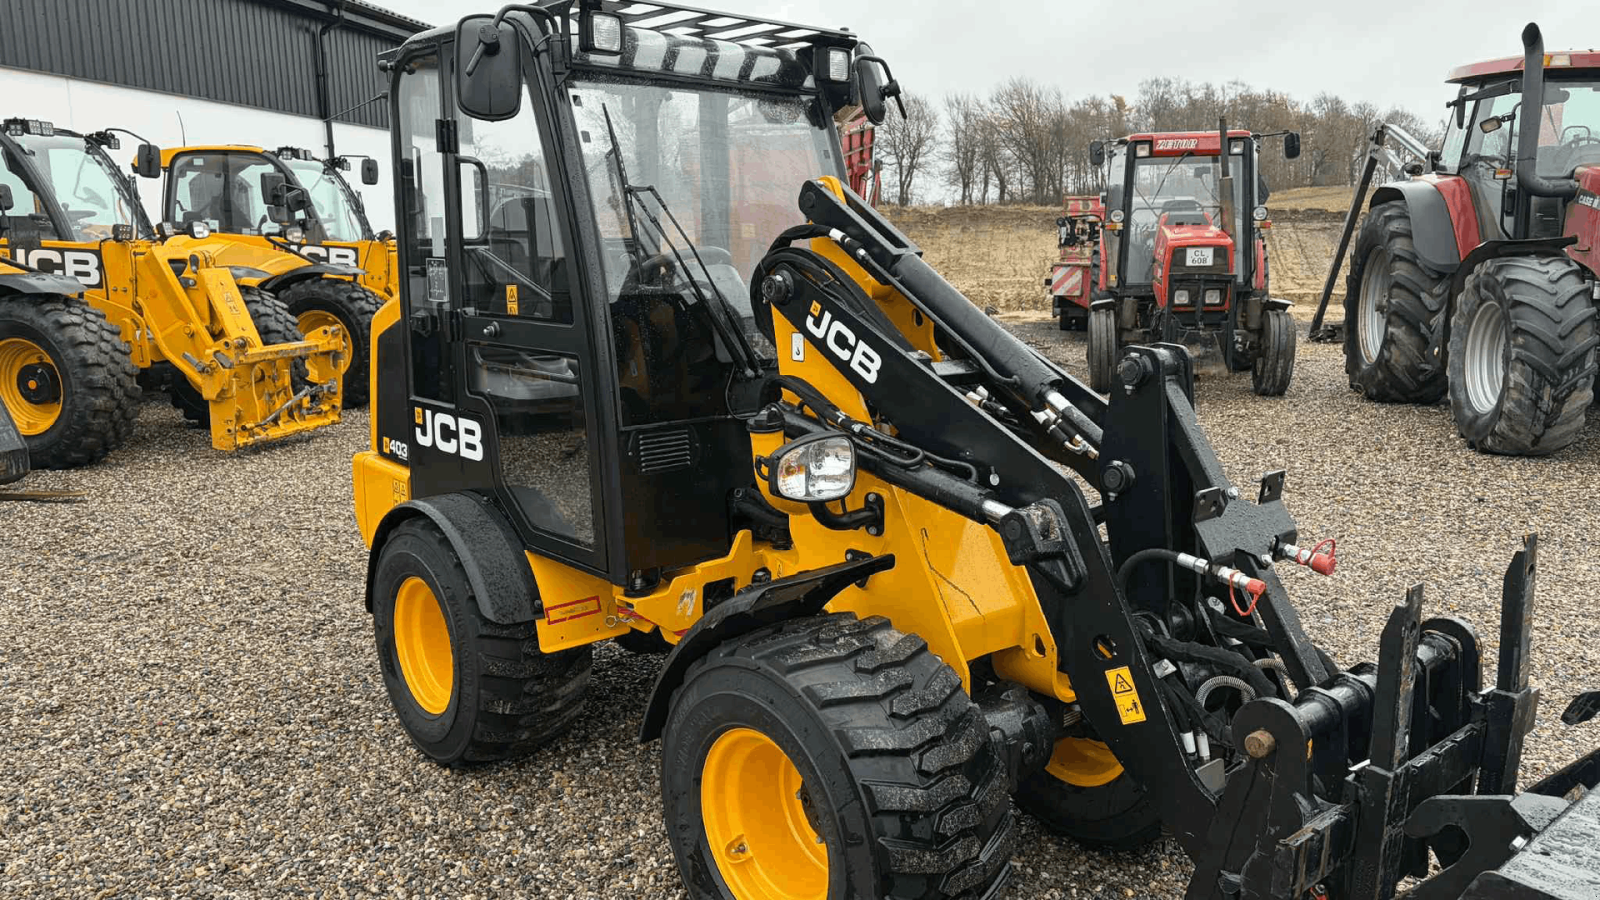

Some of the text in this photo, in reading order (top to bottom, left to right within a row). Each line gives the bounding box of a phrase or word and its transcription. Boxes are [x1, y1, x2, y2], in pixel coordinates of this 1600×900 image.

[290, 244, 357, 267] CB
[1191, 257, 1208, 265] 608
[806, 310, 882, 384] JCB
[415, 409, 483, 461] JCB
[389, 439, 408, 458] 403
